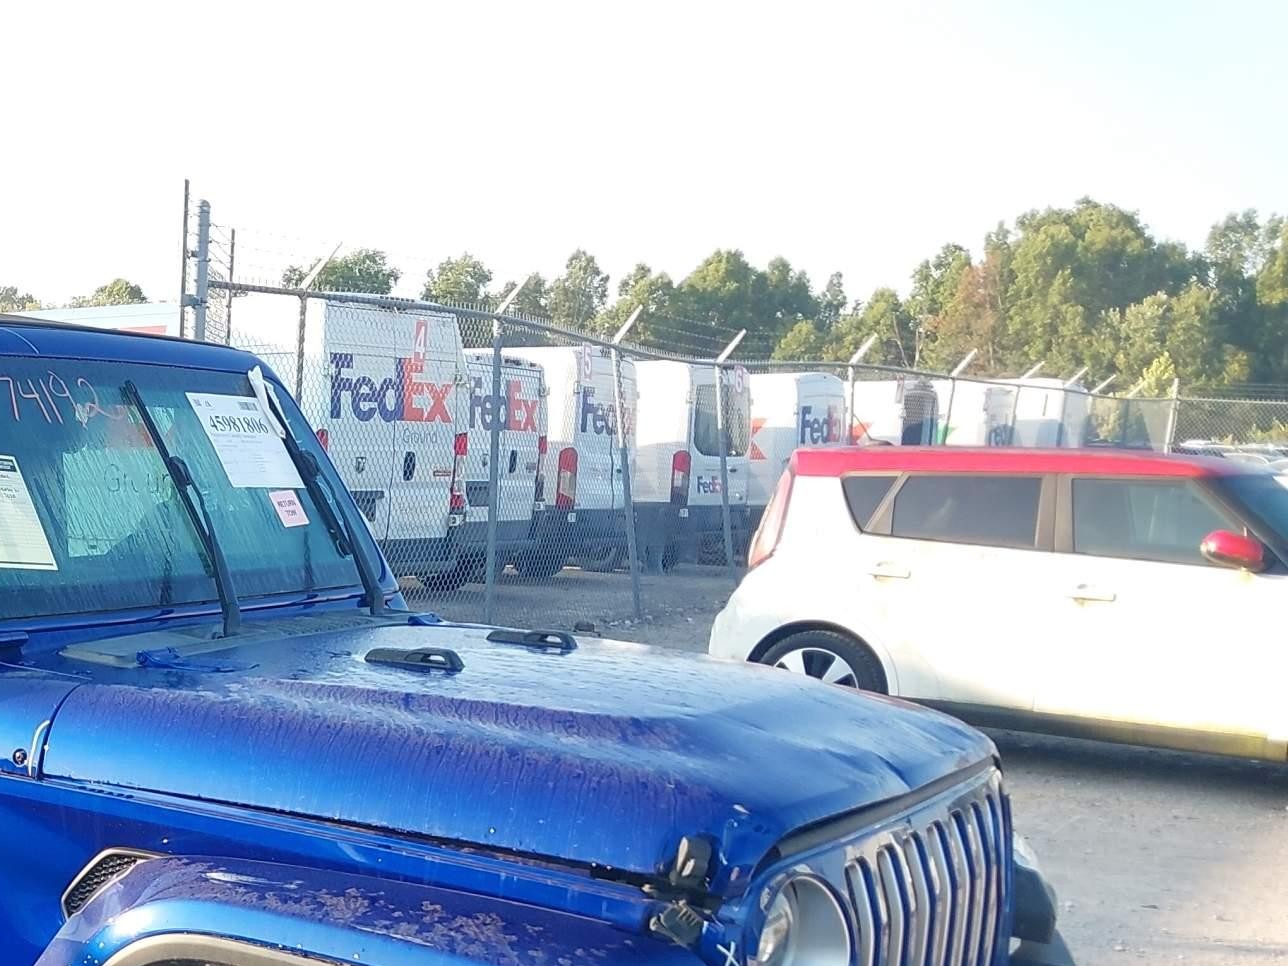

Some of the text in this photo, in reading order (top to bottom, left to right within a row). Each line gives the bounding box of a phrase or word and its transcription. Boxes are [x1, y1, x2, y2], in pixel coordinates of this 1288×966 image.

[414, 325, 426, 353] 4
[583, 347, 593, 377] 5
[329, 352, 453, 423] FedEx
[735, 369, 744, 393] 6
[209, 415, 269, 434] 45981806
[402, 428, 438, 444] Ground
